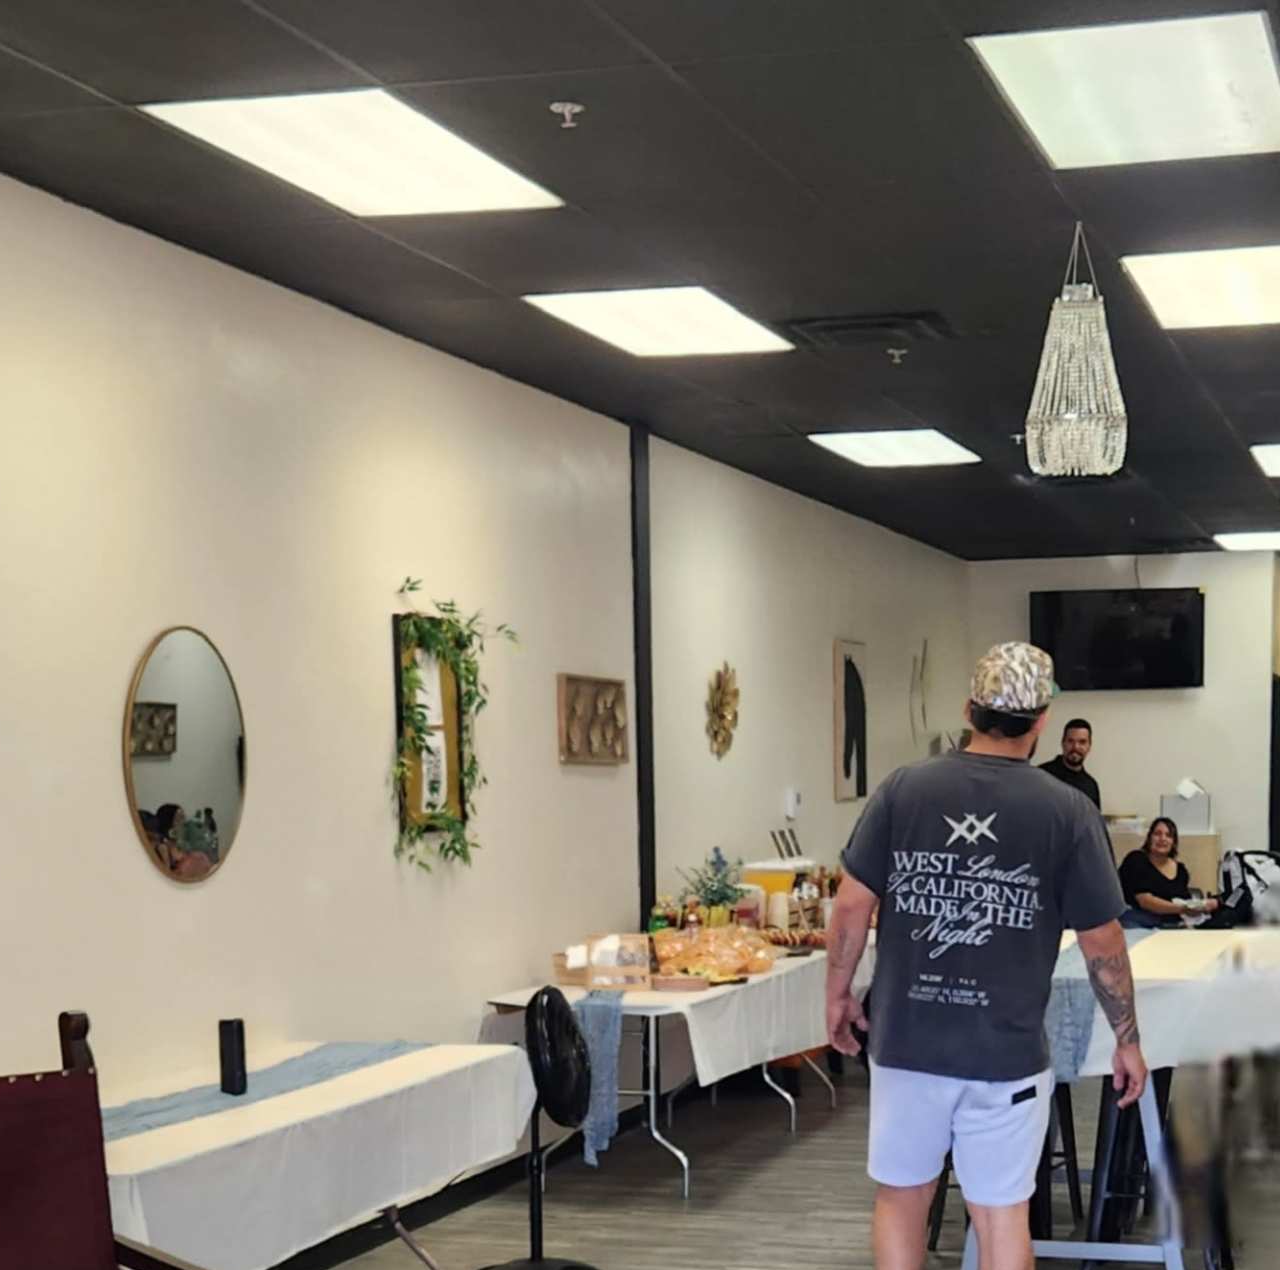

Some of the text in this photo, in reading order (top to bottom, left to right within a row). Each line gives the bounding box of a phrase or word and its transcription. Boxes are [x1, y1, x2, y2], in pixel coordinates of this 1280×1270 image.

[887, 872, 915, 894] To
[893, 851, 1040, 887] WEST London
[895, 895, 959, 919] MADE
[981, 902, 1034, 930] THE
[910, 914, 993, 959] Night
